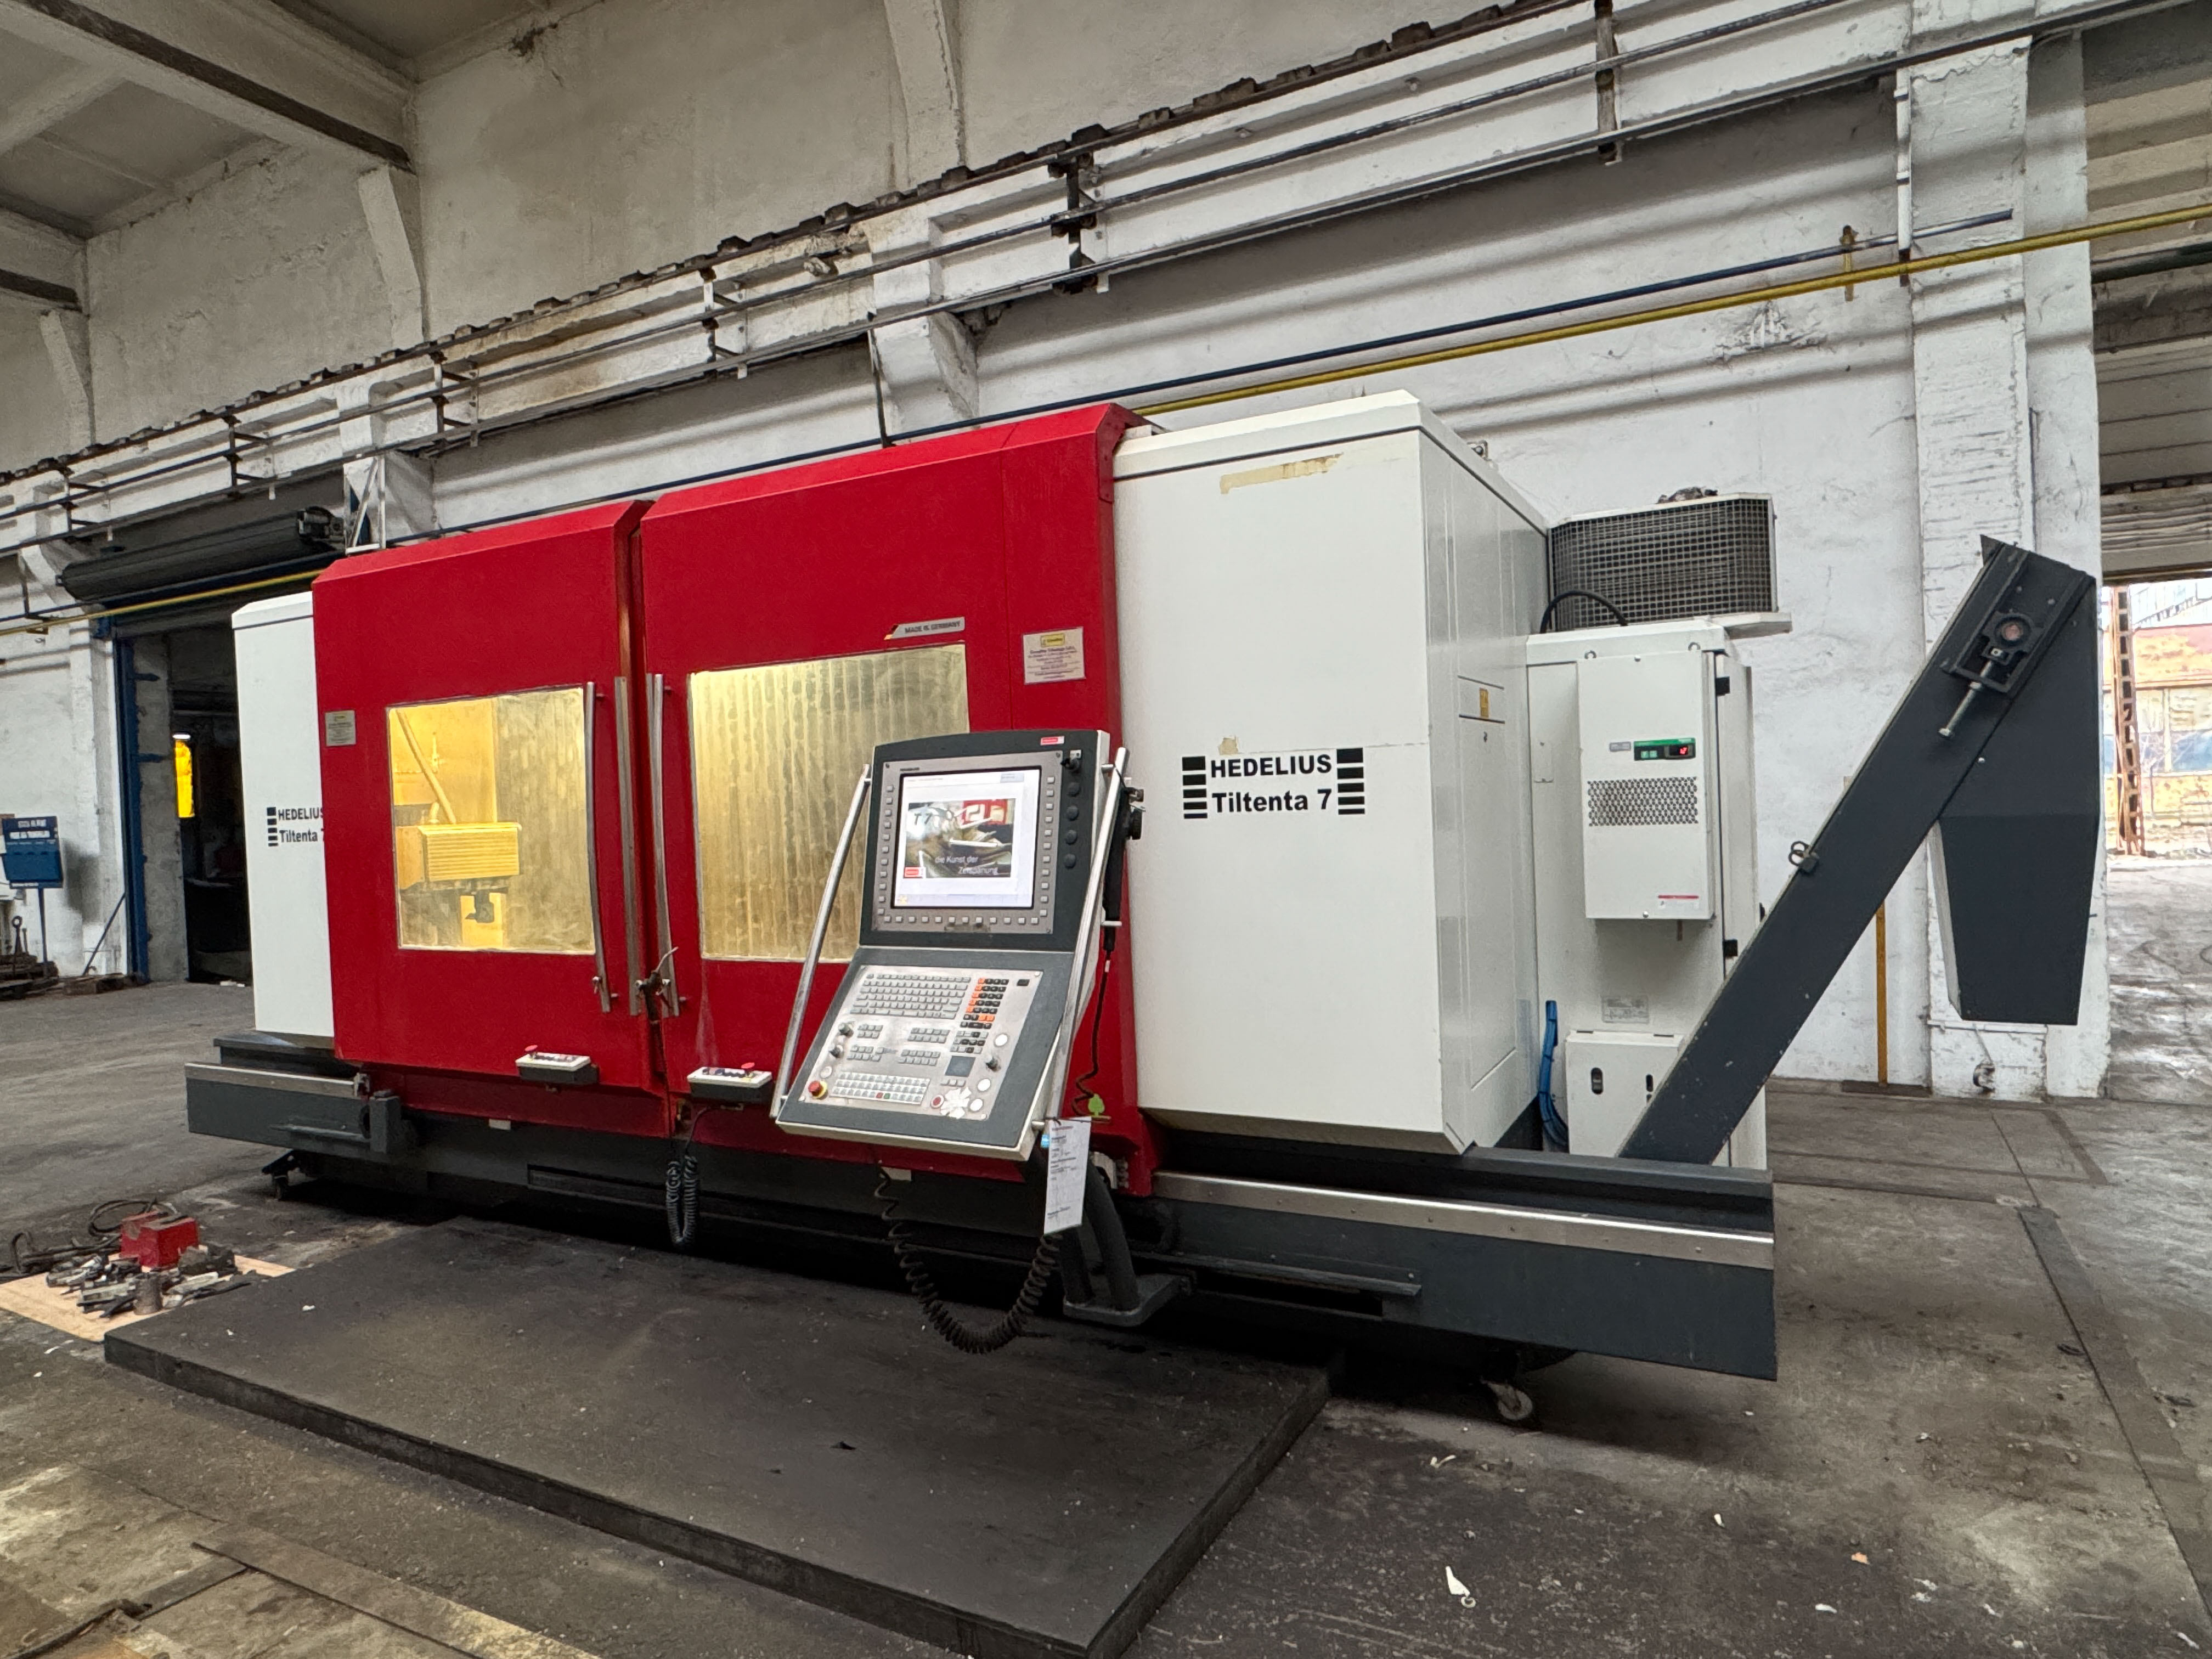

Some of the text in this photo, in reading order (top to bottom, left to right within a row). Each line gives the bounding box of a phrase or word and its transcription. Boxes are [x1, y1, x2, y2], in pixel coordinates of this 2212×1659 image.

[1211, 754, 1332, 778] HEDELIUS
[1212, 788, 1332, 813] Tiltenta 7
[279, 828, 318, 843] Tiltenta
